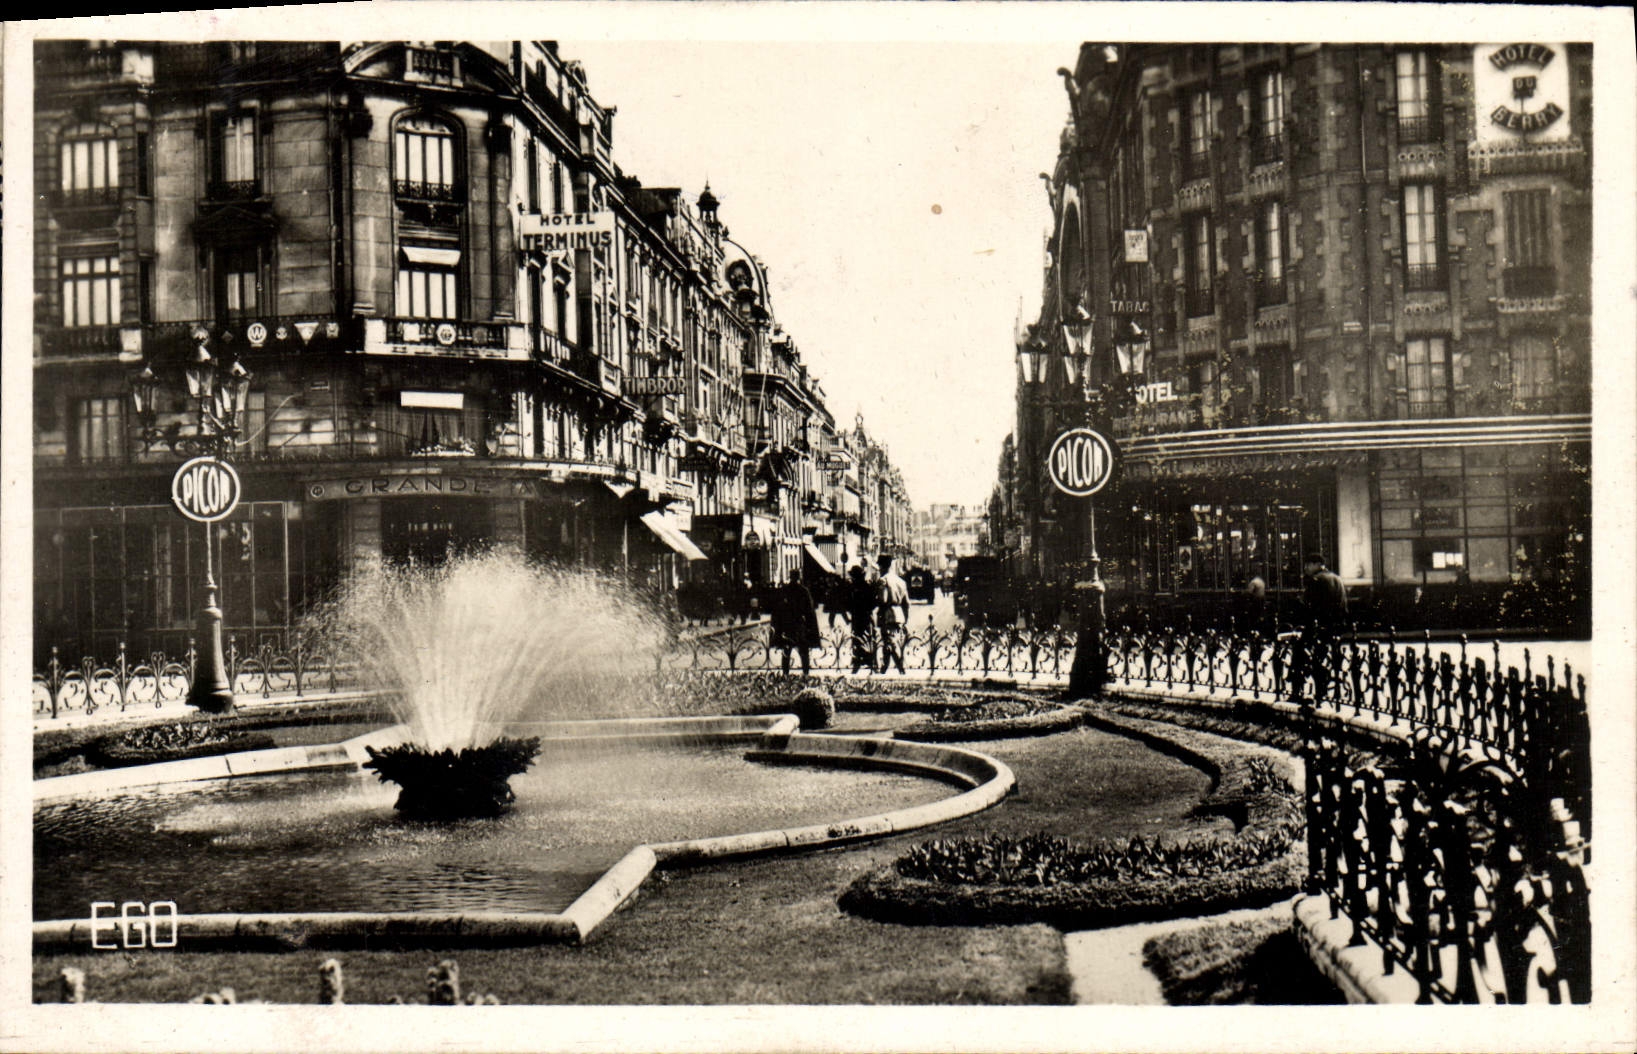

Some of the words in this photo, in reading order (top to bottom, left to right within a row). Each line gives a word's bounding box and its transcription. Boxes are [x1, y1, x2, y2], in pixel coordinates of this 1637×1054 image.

[1492, 43, 1549, 68] HOTEL
[1515, 77, 1535, 90] DU
[1492, 104, 1558, 130] BERRY
[540, 214, 596, 226] HOTEL
[522, 230, 613, 251] TERMINUS
[1110, 299, 1150, 313] TABAC
[622, 377, 686, 395] TIMBROR
[1133, 381, 1178, 404] OTEL
[1057, 436, 1103, 488] PICON
[182, 464, 230, 515] PICON
[345, 476, 491, 494] GRANDE
